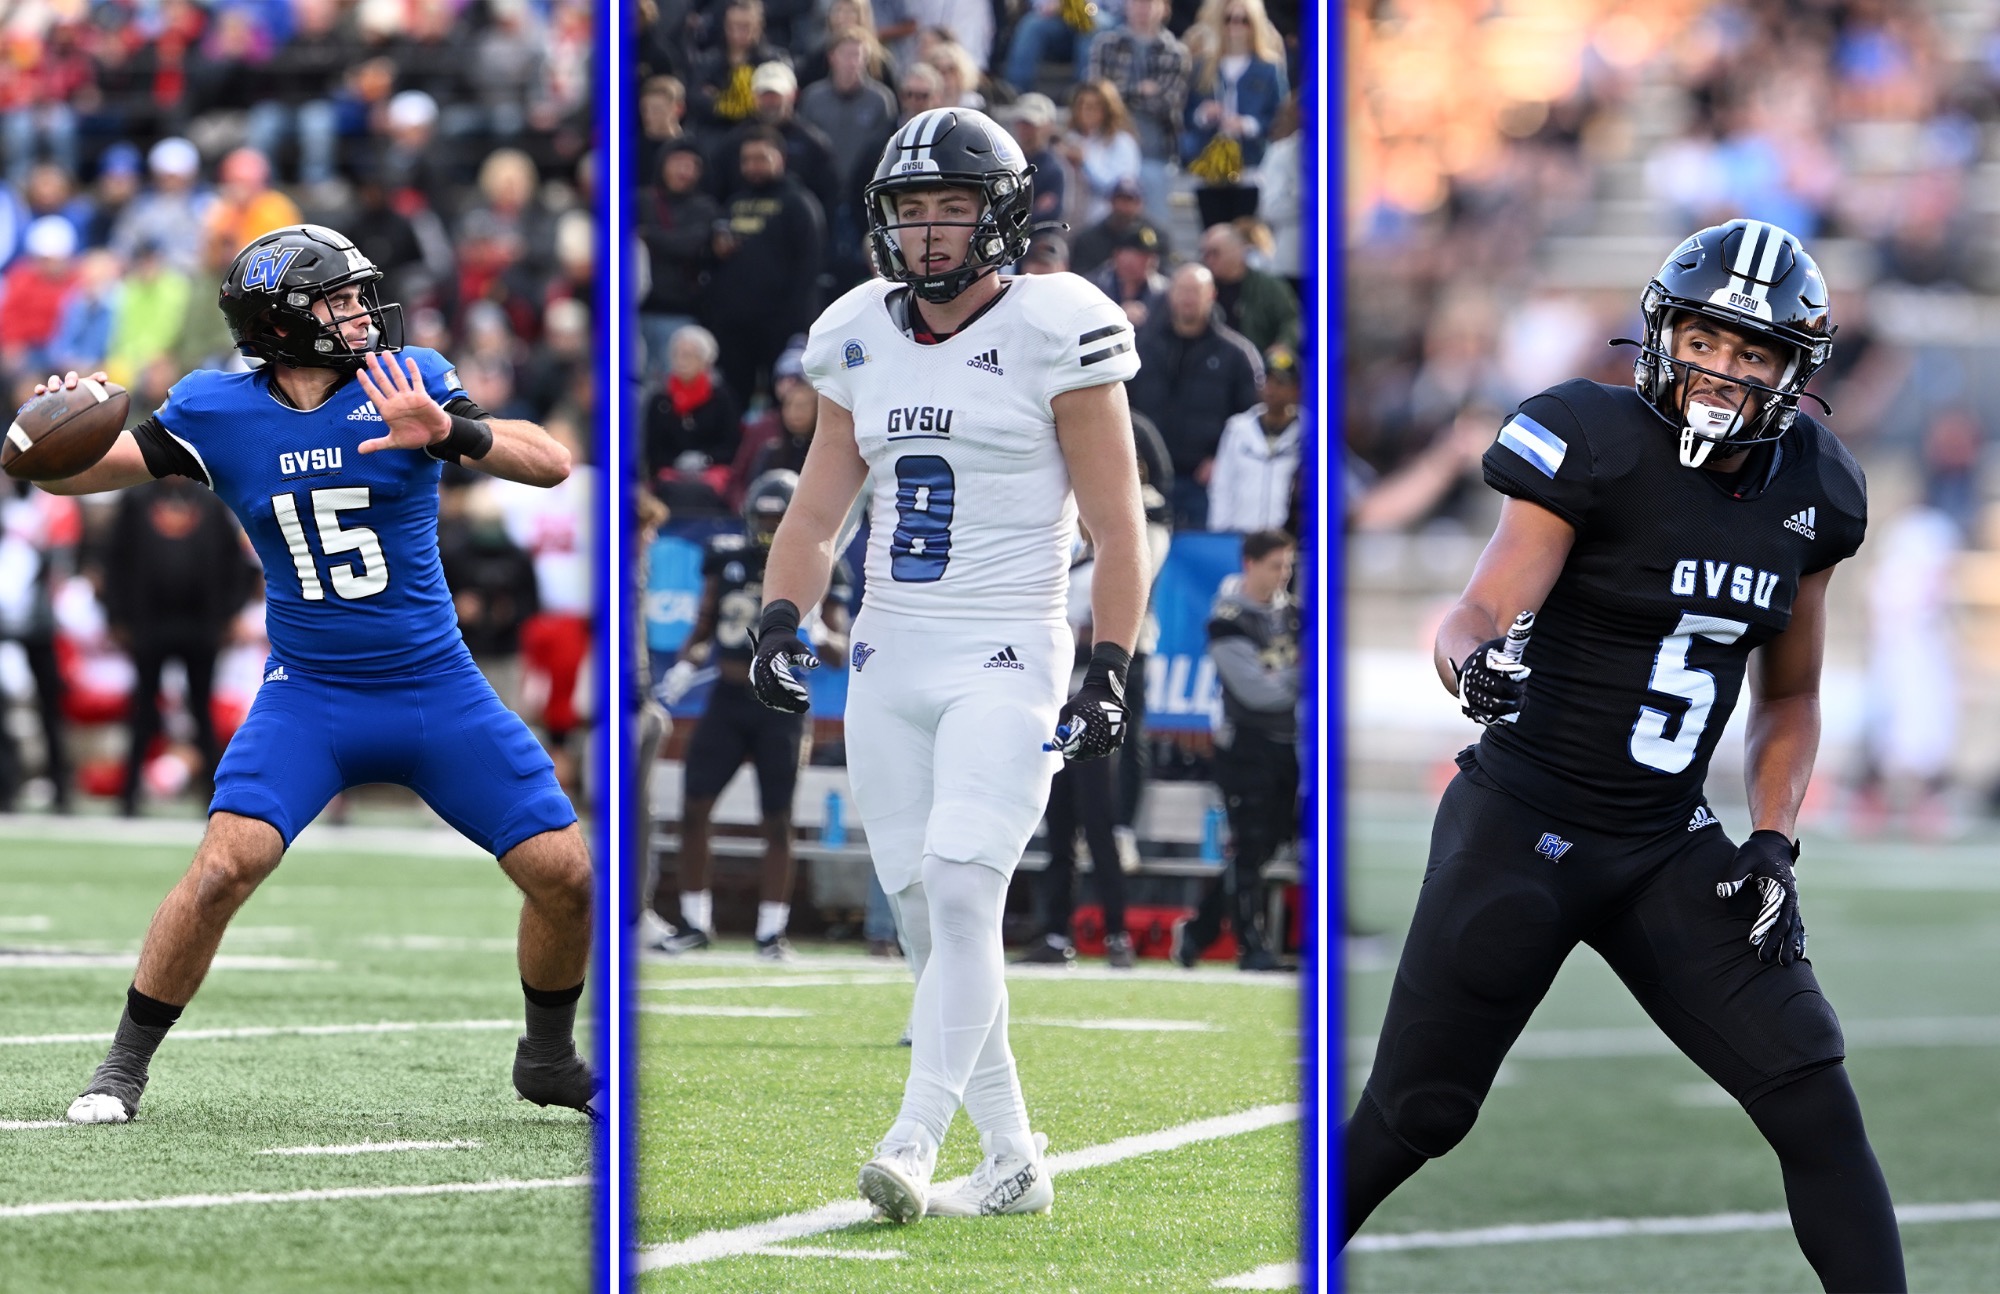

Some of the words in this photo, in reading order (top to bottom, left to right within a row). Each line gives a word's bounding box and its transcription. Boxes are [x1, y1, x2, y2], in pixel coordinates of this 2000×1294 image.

[902, 161, 924, 172] GVSU
[242, 244, 304, 294] GV
[1730, 292, 1759, 312] GVSU
[966, 358, 1004, 376] adidas
[347, 413, 383, 422] adidas
[888, 406, 954, 434] GVSU
[279, 447, 343, 475] GVSU
[890, 455, 955, 583] 8
[1783, 518, 1816, 541] adidas
[271, 486, 389, 600] 15
[1670, 558, 1780, 610] GVSU
[852, 641, 876, 673] GV
[983, 659, 1025, 671] adidas
[1627, 610, 1750, 775] 5
[1535, 832, 1573, 860] GV
